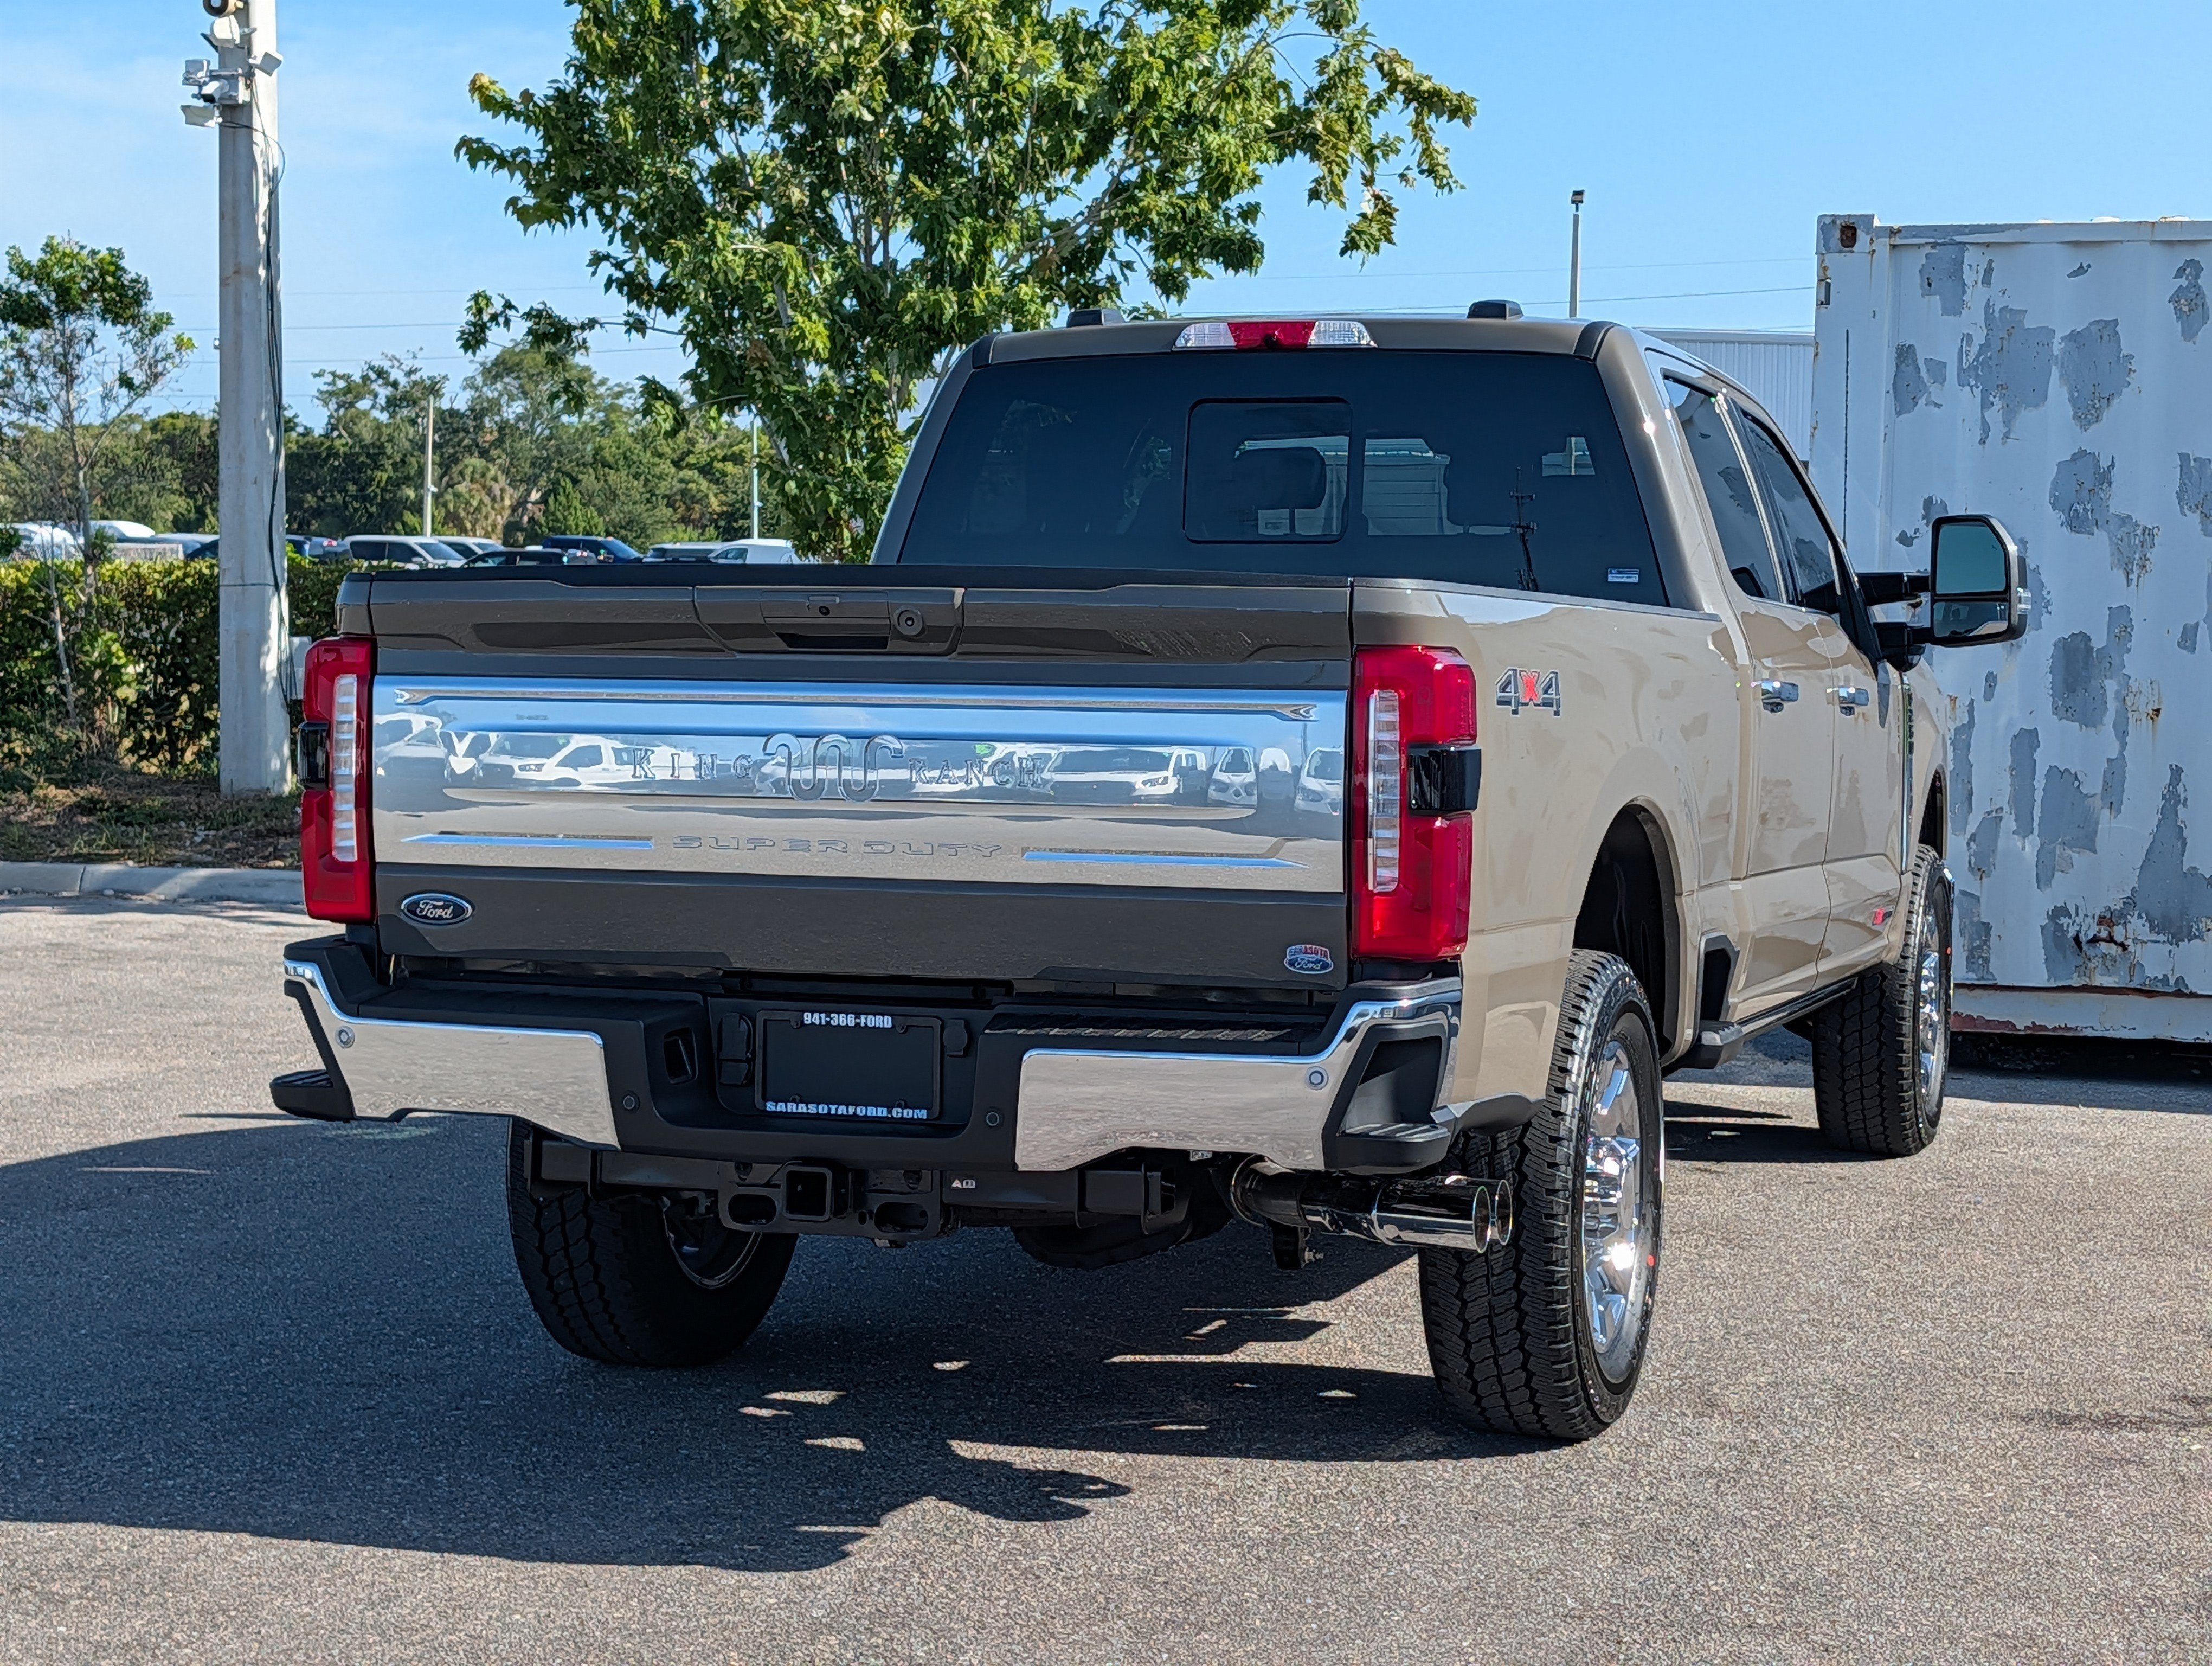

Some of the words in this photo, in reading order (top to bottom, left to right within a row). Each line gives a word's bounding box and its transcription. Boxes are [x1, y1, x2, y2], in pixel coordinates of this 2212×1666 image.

[631, 748, 753, 780] KING
[909, 757, 1041, 788] RANCH
[673, 836, 848, 854] SUPER
[863, 841, 1001, 857] DUTY
[417, 900, 453, 918] Ford
[803, 1012, 892, 1028] 941-366-FORD
[766, 1101, 927, 1119] SARASOTAFORD.COM
